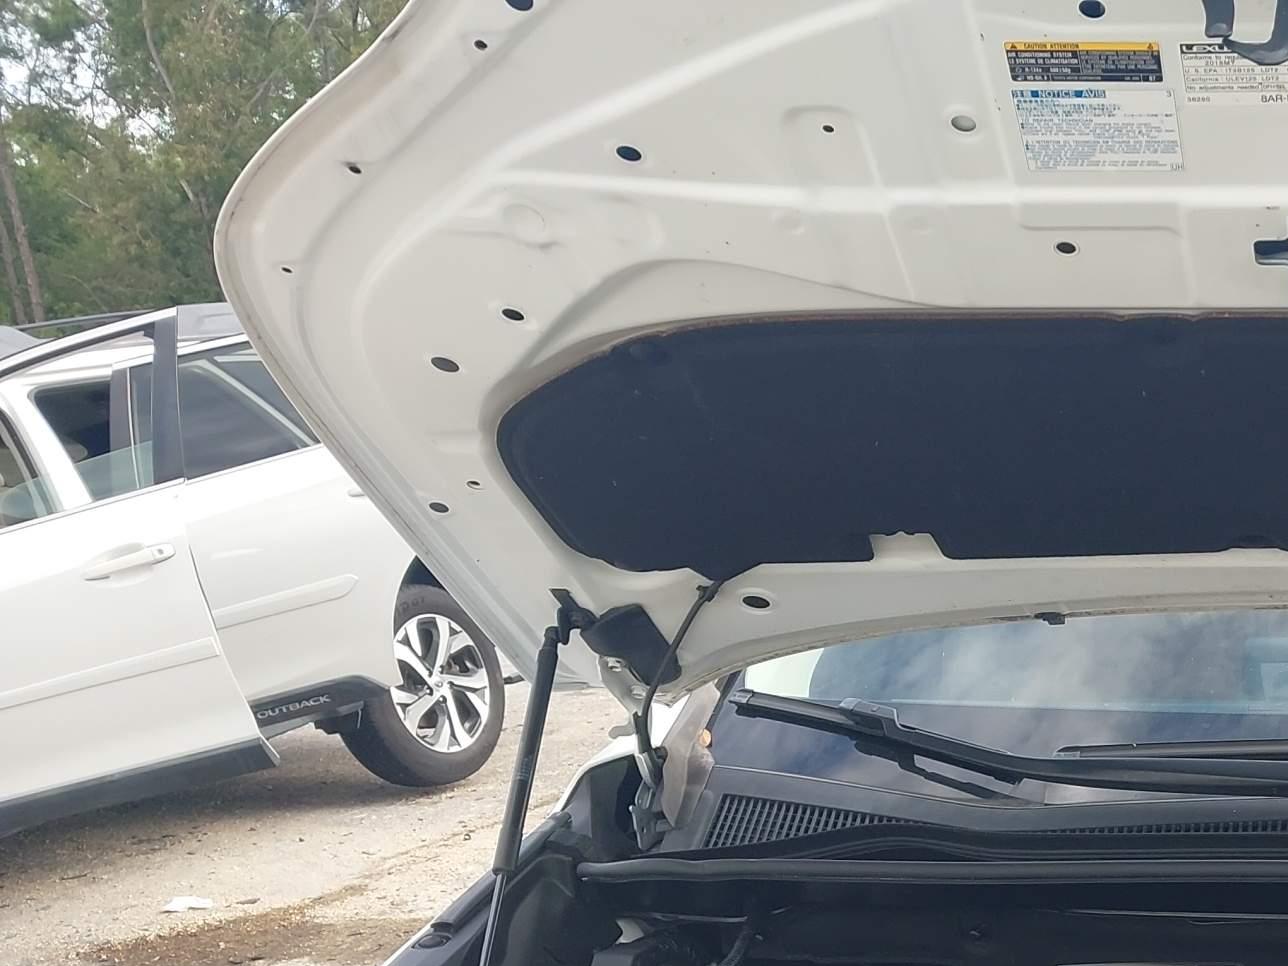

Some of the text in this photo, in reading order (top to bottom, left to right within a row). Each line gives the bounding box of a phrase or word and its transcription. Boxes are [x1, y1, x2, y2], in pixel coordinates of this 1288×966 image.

[1039, 90, 1076, 98] NOTICE
[1082, 90, 1106, 98] AVIS
[256, 694, 331, 719] OUTBACK
